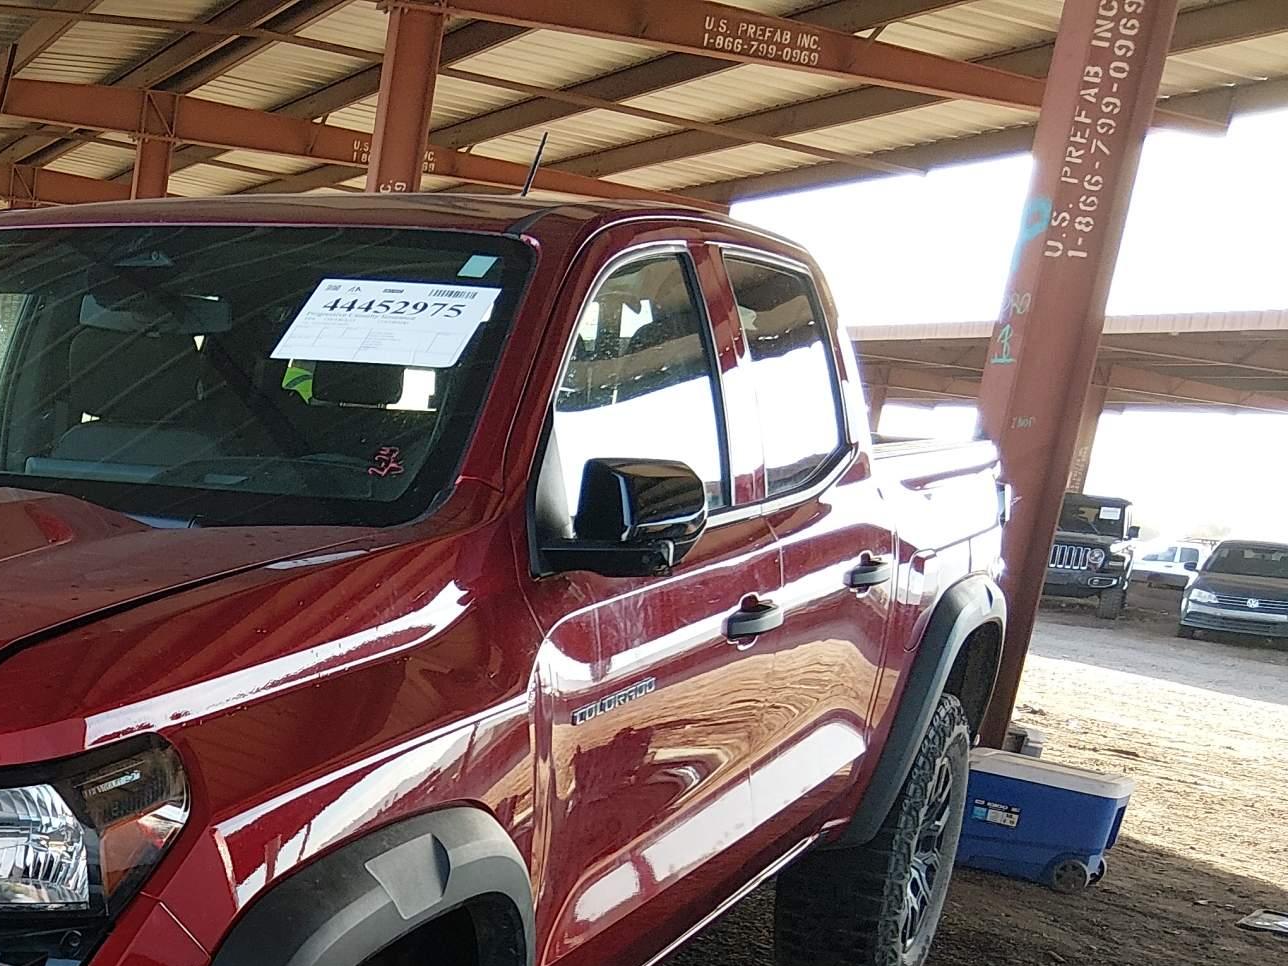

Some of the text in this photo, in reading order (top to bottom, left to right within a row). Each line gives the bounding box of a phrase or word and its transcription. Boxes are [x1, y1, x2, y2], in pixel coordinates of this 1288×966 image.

[703, 33, 820, 66] 1-866-799-0969
[704, 16, 821, 50] U.S. PREFAB INC.
[1044, 203, 1074, 258] U.S.
[1060, 65, 1103, 184] PREFAB
[322, 297, 467, 319] 44452975
[573, 677, 657, 725] COLORADO
